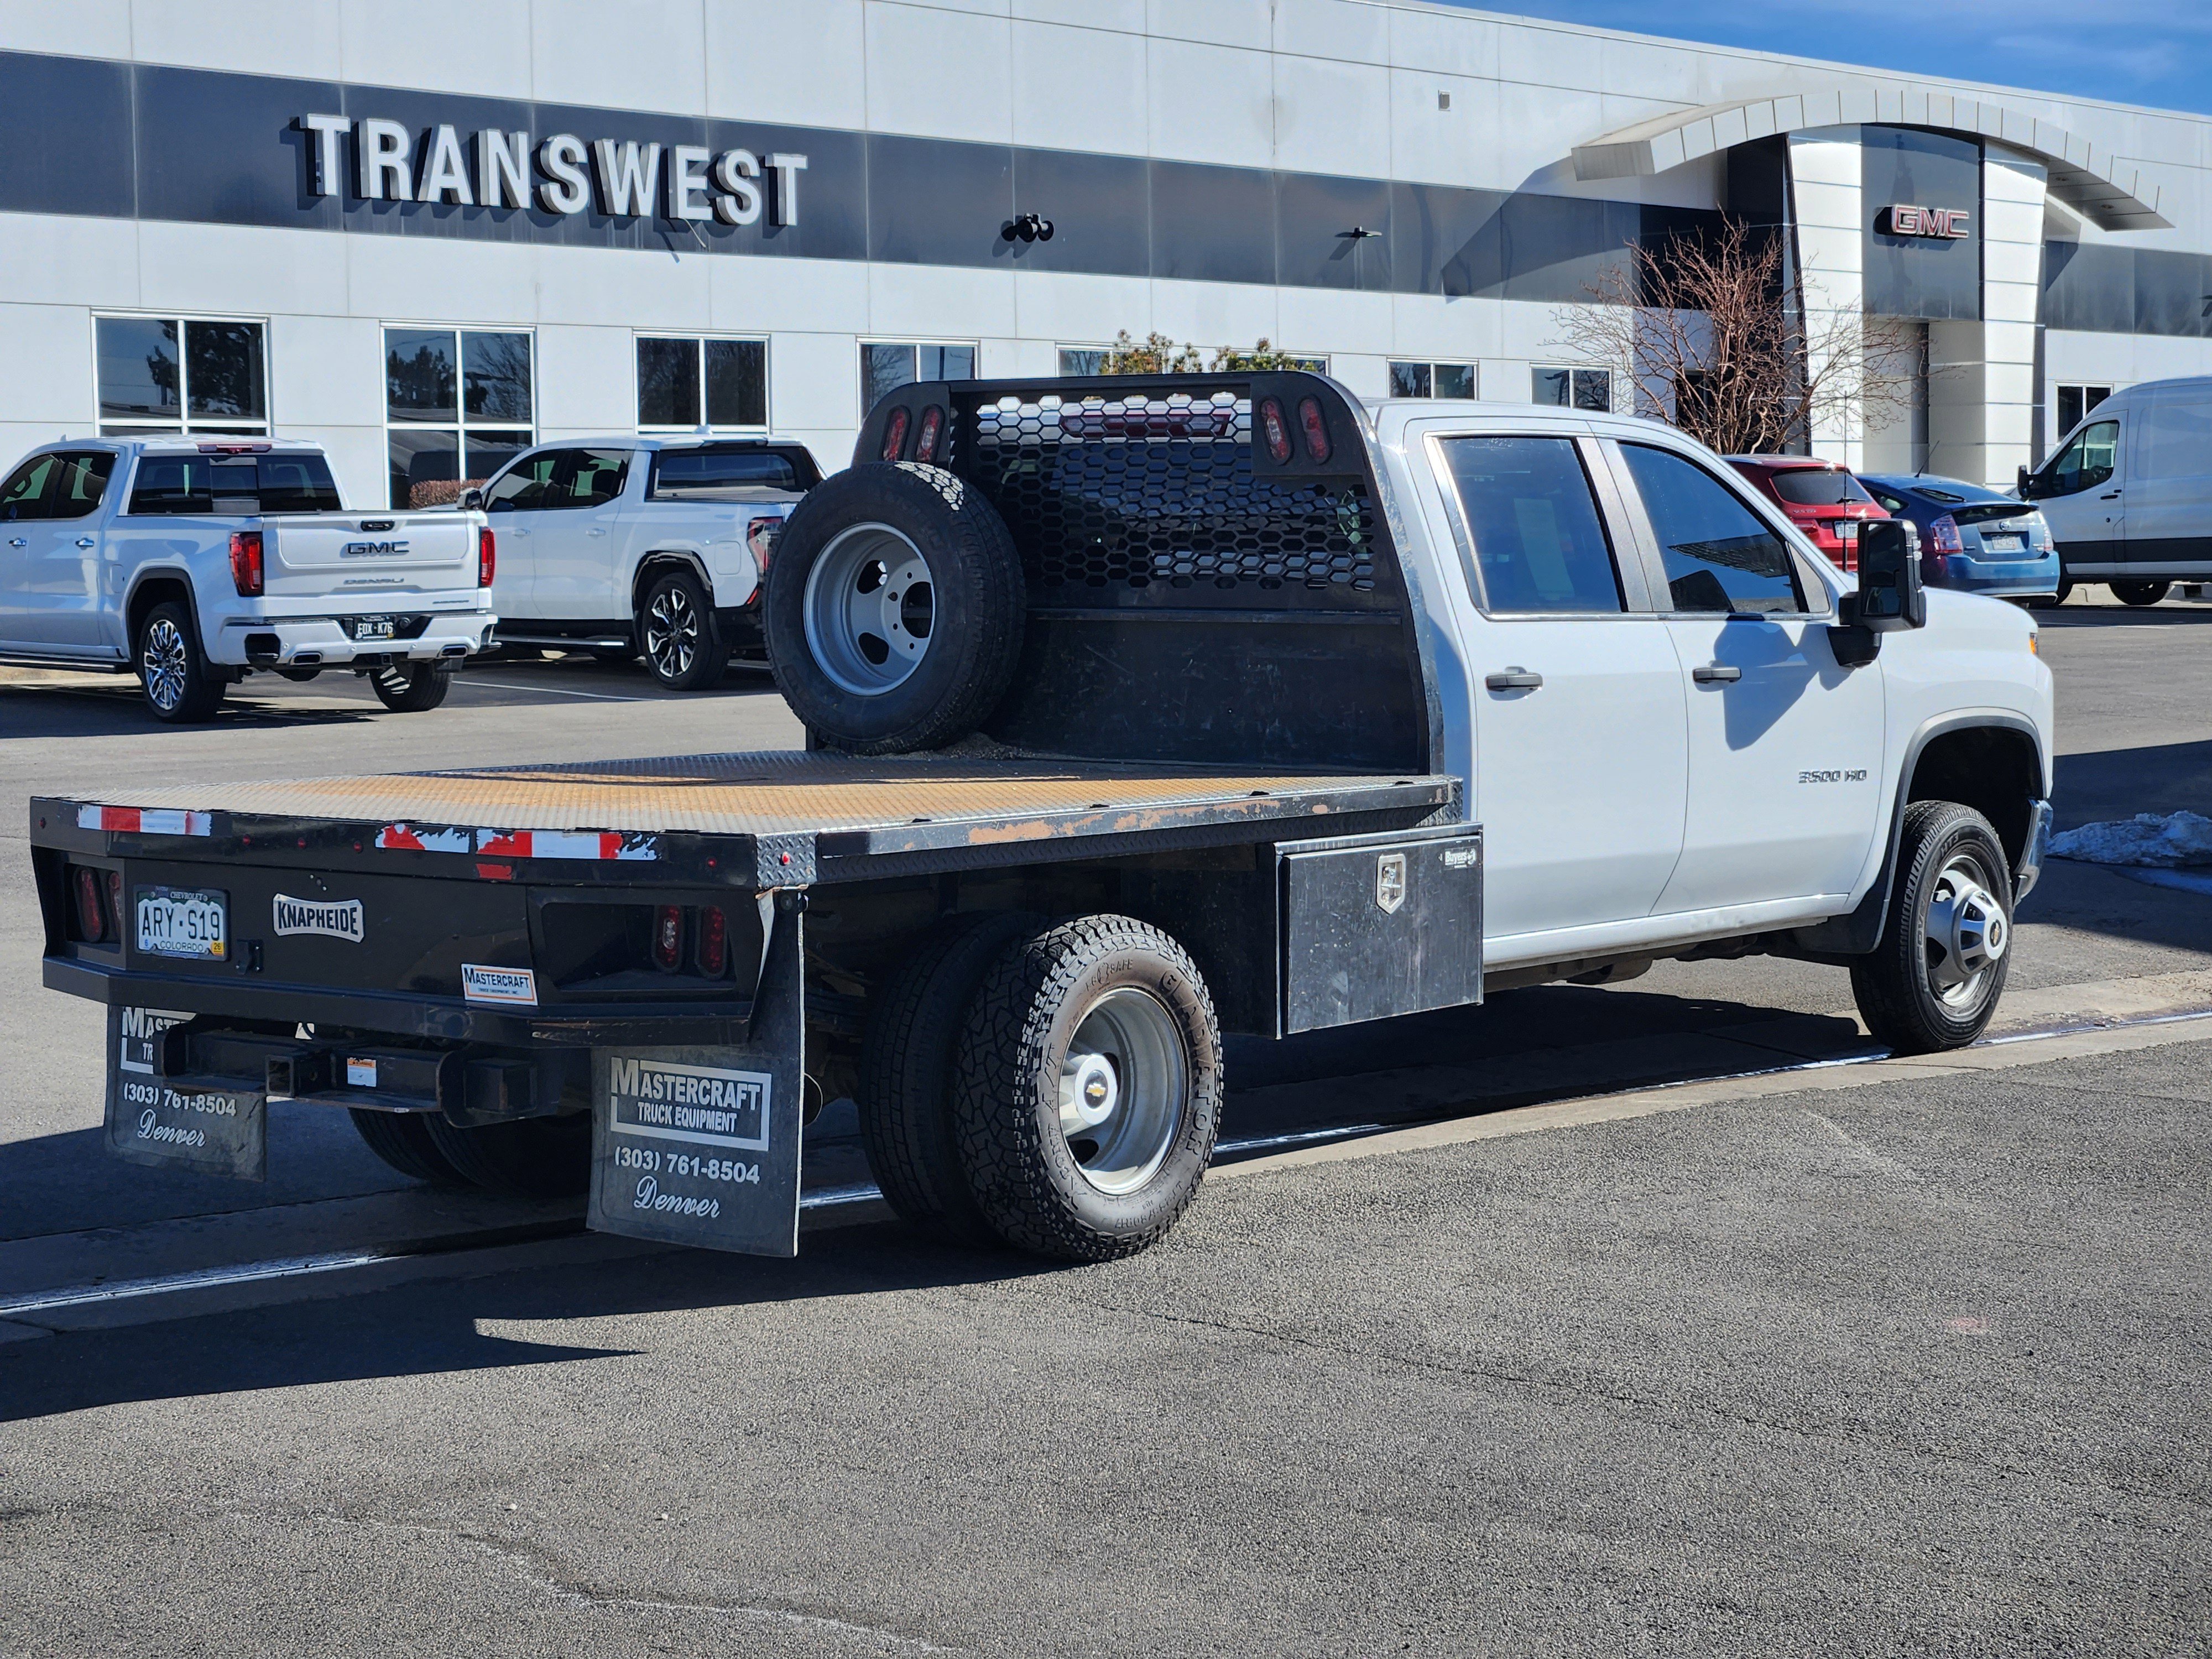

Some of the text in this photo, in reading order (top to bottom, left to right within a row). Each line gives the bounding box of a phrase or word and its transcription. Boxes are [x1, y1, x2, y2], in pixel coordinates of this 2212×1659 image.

[306, 113, 808, 226] TRANSWEST
[1891, 204, 1969, 238] GMC
[347, 541, 410, 555] GMC
[1798, 769, 1841, 783] 3500
[170, 891, 204, 901] CHEVROLET
[278, 901, 358, 936] KNAPHEIDE
[160, 940, 204, 952] COLORADO
[463, 967, 529, 989] MASTERCRAFT
[1160, 969, 1213, 1156] GLADIATOR
[123, 1082, 237, 1117] (303) 761-8504
[611, 1056, 760, 1110] MASTERCRAFT
[137, 1108, 206, 1147] Denver
[638, 1101, 737, 1133] TRUCK EQUIPMENT
[614, 1146, 760, 1185] (303) 761-8504
[633, 1175, 721, 1218] Denver
